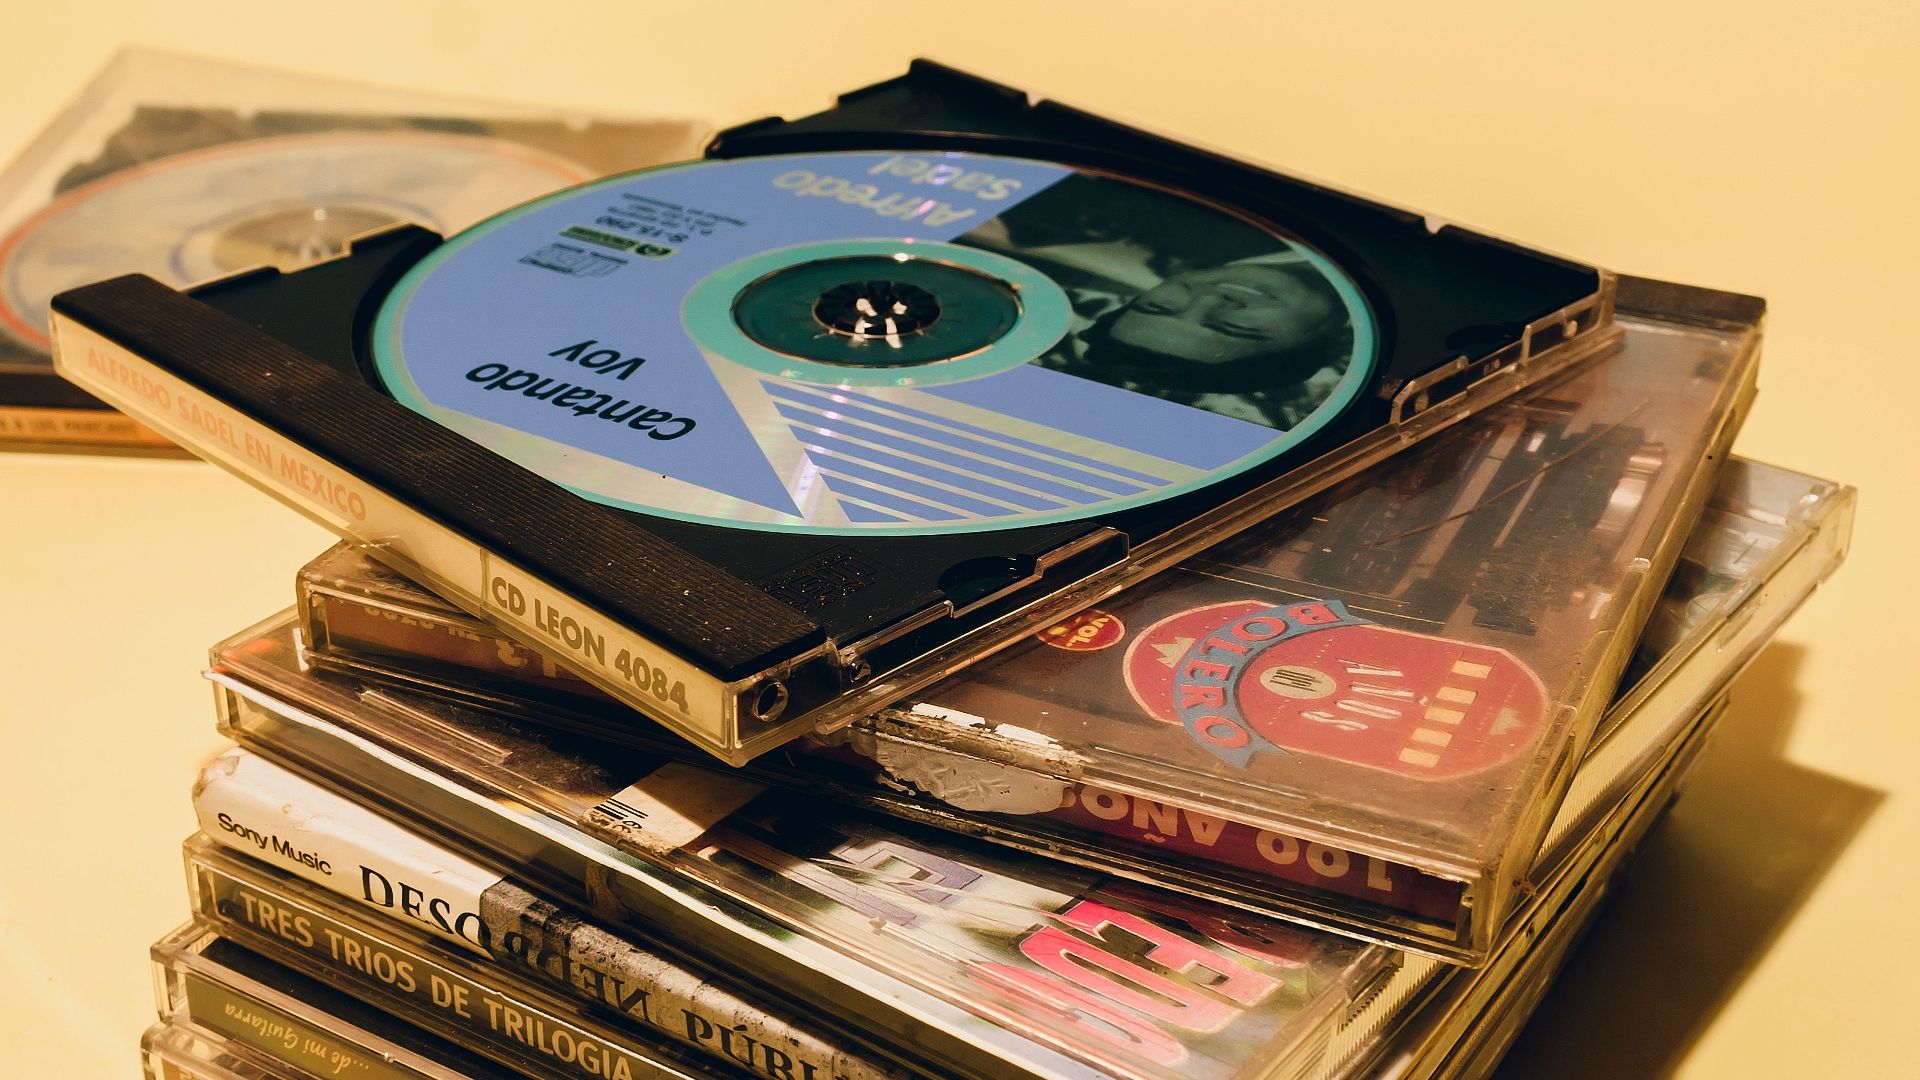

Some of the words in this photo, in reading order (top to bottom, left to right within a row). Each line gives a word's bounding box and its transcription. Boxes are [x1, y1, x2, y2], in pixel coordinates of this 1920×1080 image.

[773, 169, 977, 227] Alfredo
[868, 156, 1023, 201] Sadel
[87, 347, 172, 410] ALFREDO
[178, 395, 240, 451] SADEL
[245, 431, 274, 471] EN
[281, 452, 367, 522] MEXICO
[491, 576, 527, 617] CD
[534, 598, 606, 667] LEON
[614, 648, 691, 716] 4084
[1180, 603, 1342, 749] BOLERO
[217, 812, 269, 850] Sony
[272, 835, 333, 876] Music
[1255, 829, 1394, 893] 100
[240, 890, 314, 949] TRES
[324, 928, 417, 994] TRIOS
[431, 975, 472, 1019] DE
[482, 997, 634, 1080] TRILOGIA
[224, 1003, 299, 1049] Guitarra
[302, 1039, 327, 1059] mi
